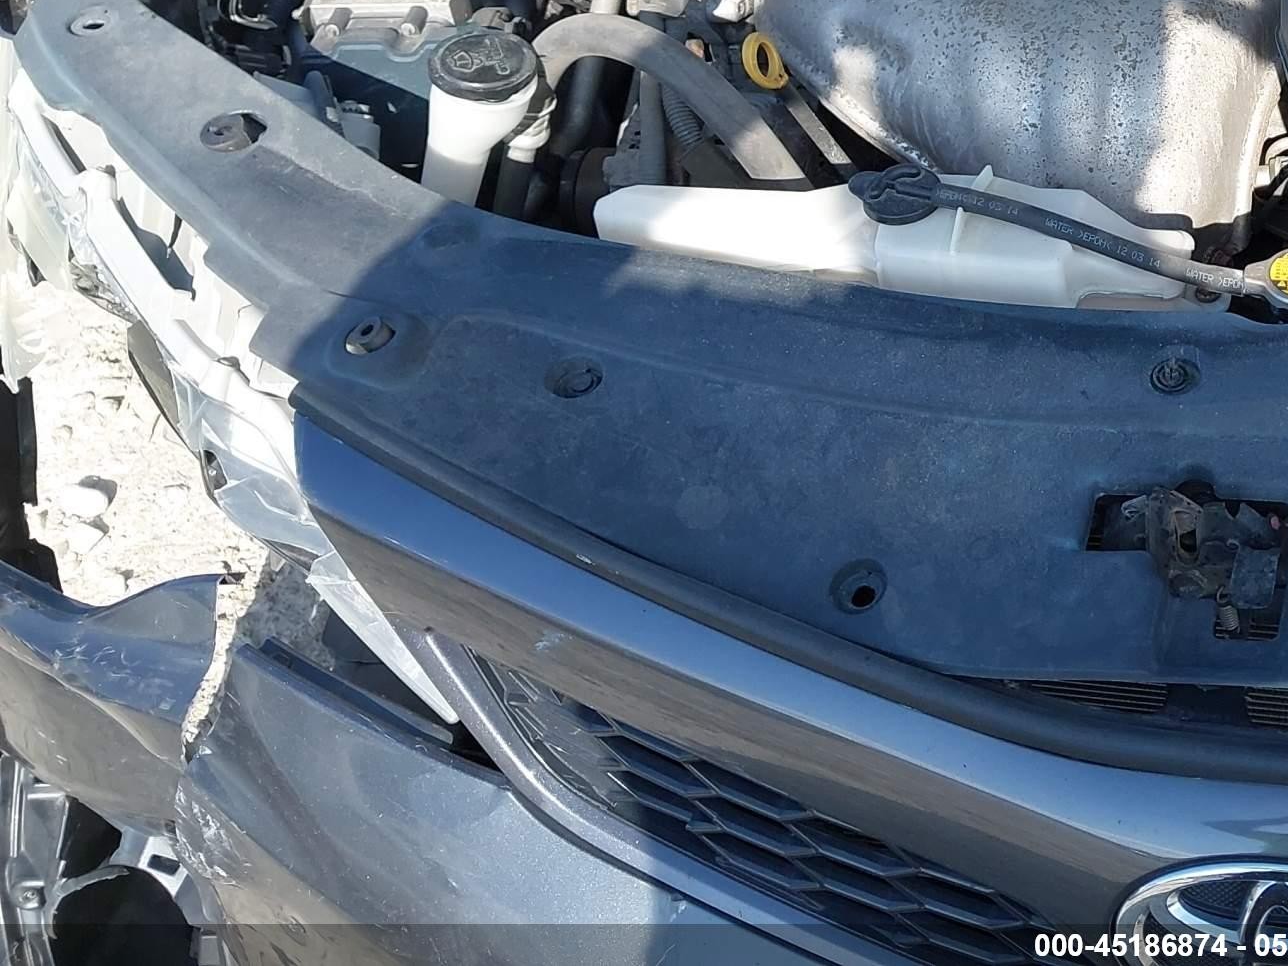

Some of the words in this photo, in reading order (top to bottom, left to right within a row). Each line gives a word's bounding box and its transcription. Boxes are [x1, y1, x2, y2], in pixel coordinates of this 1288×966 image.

[1044, 217, 1073, 235] WATER
[1116, 245, 1128, 256] 12
[1131, 250, 1145, 262] 03
[1148, 257, 1161, 268] 14
[1185, 267, 1214, 283] WATER
